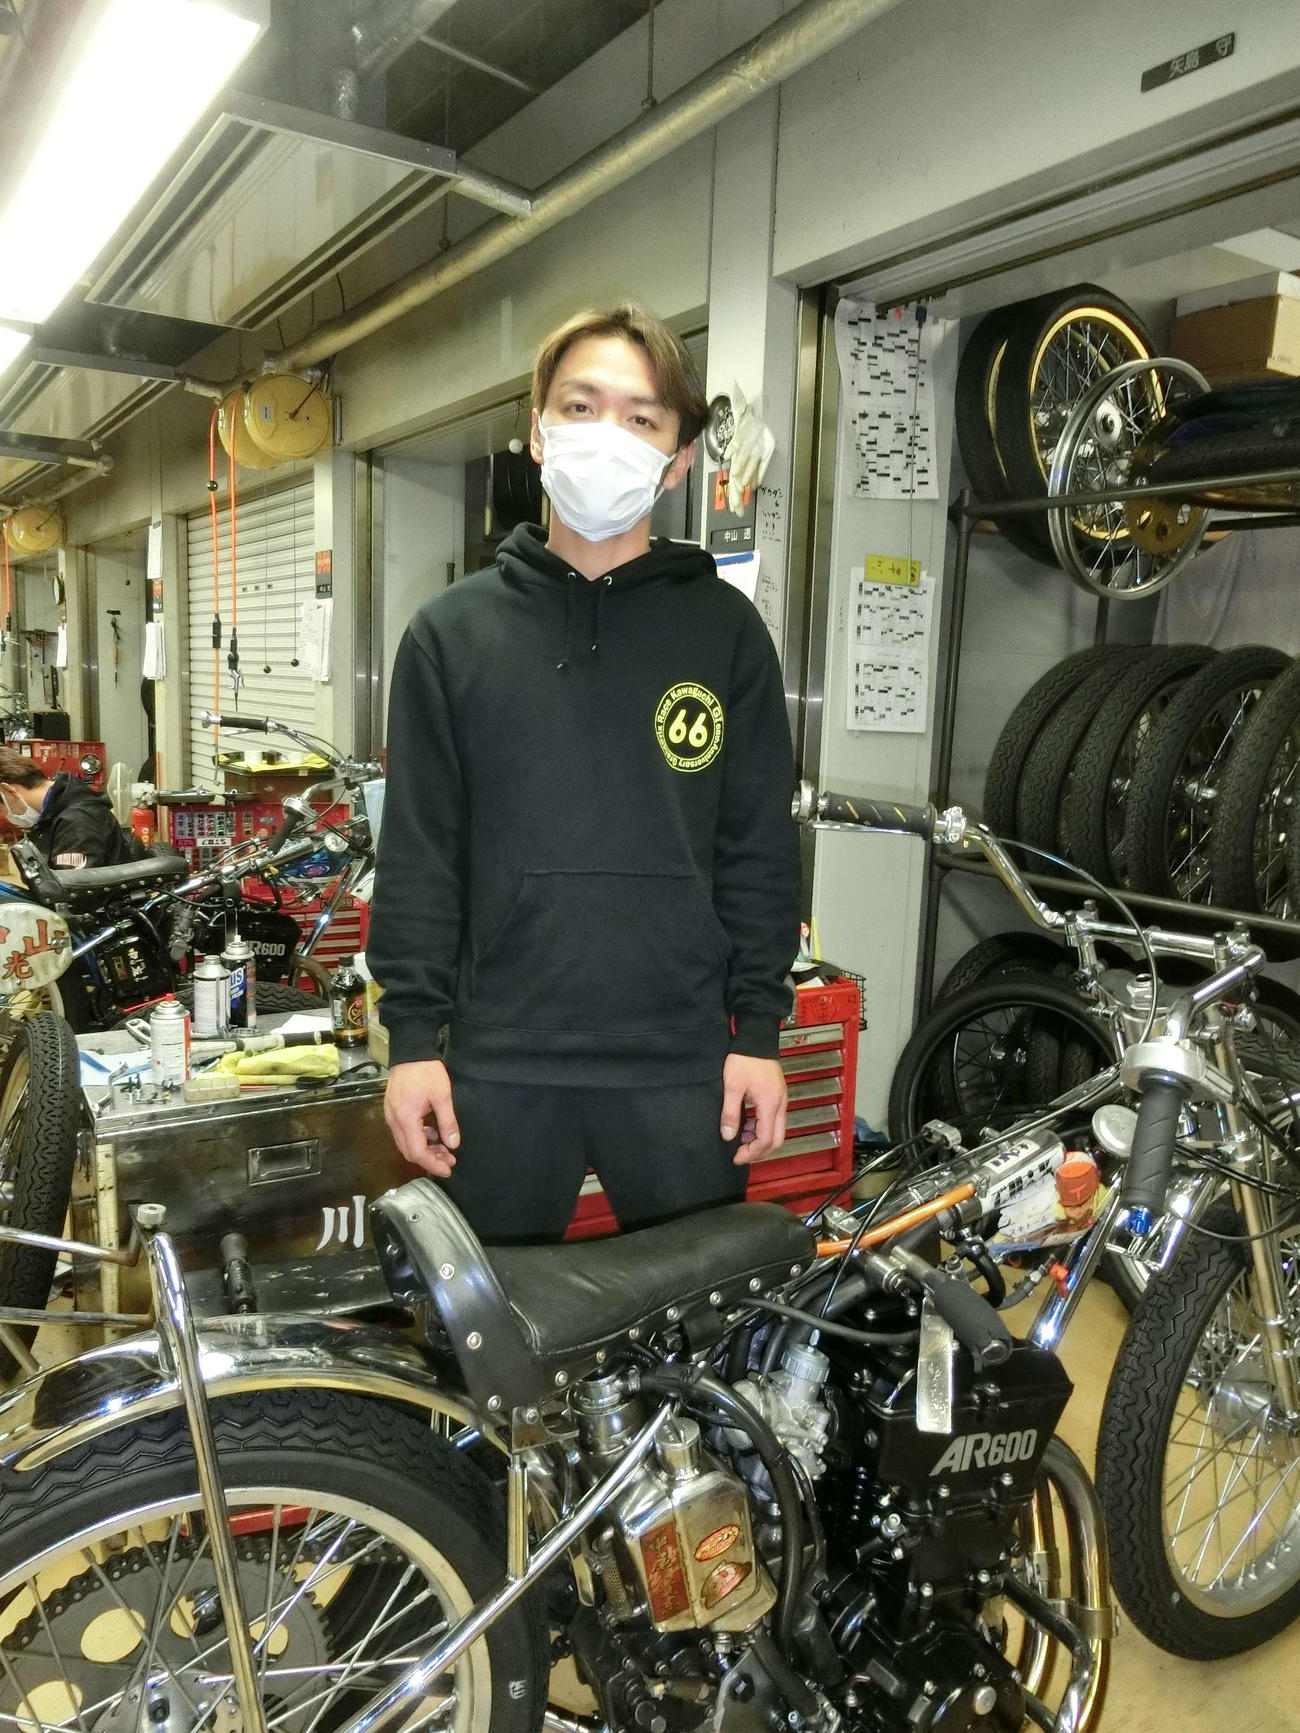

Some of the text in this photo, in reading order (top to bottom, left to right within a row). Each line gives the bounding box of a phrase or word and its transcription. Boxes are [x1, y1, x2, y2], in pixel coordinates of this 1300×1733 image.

[670, 687, 715, 706] Kawaguchi
[668, 709, 708, 748] 66
[2, 951, 34, 980] 光
[246, 940, 286, 957] R600
[315, 1195, 367, 1251] 川
[929, 1428, 1038, 1477] AR600
